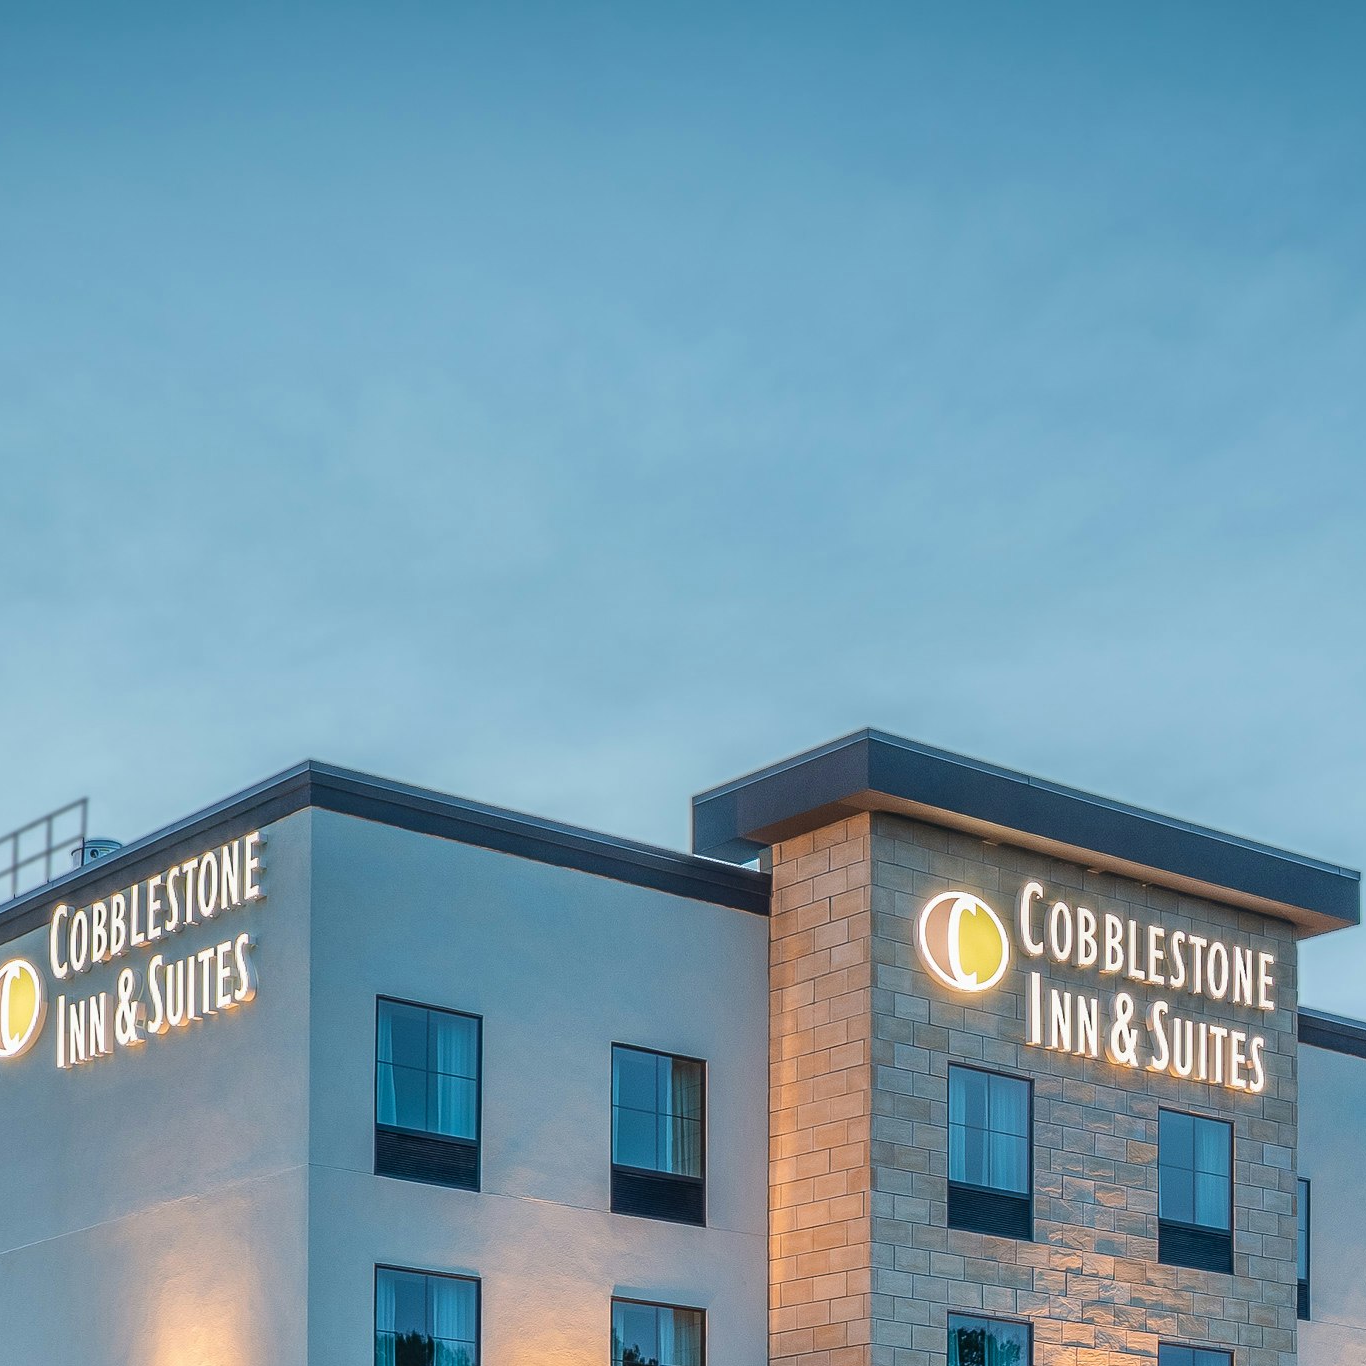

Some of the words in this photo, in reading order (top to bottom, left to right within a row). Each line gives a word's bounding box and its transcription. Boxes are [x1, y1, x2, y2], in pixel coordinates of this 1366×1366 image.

[49, 831, 262, 979] COBBLESTONE
[1018, 881, 1276, 1010] COBBLESTONE
[56, 992, 108, 1069] INN
[147, 933, 251, 1034] SUITES
[1029, 972, 1099, 1057] INN
[1150, 1000, 1265, 1093] SUITES
